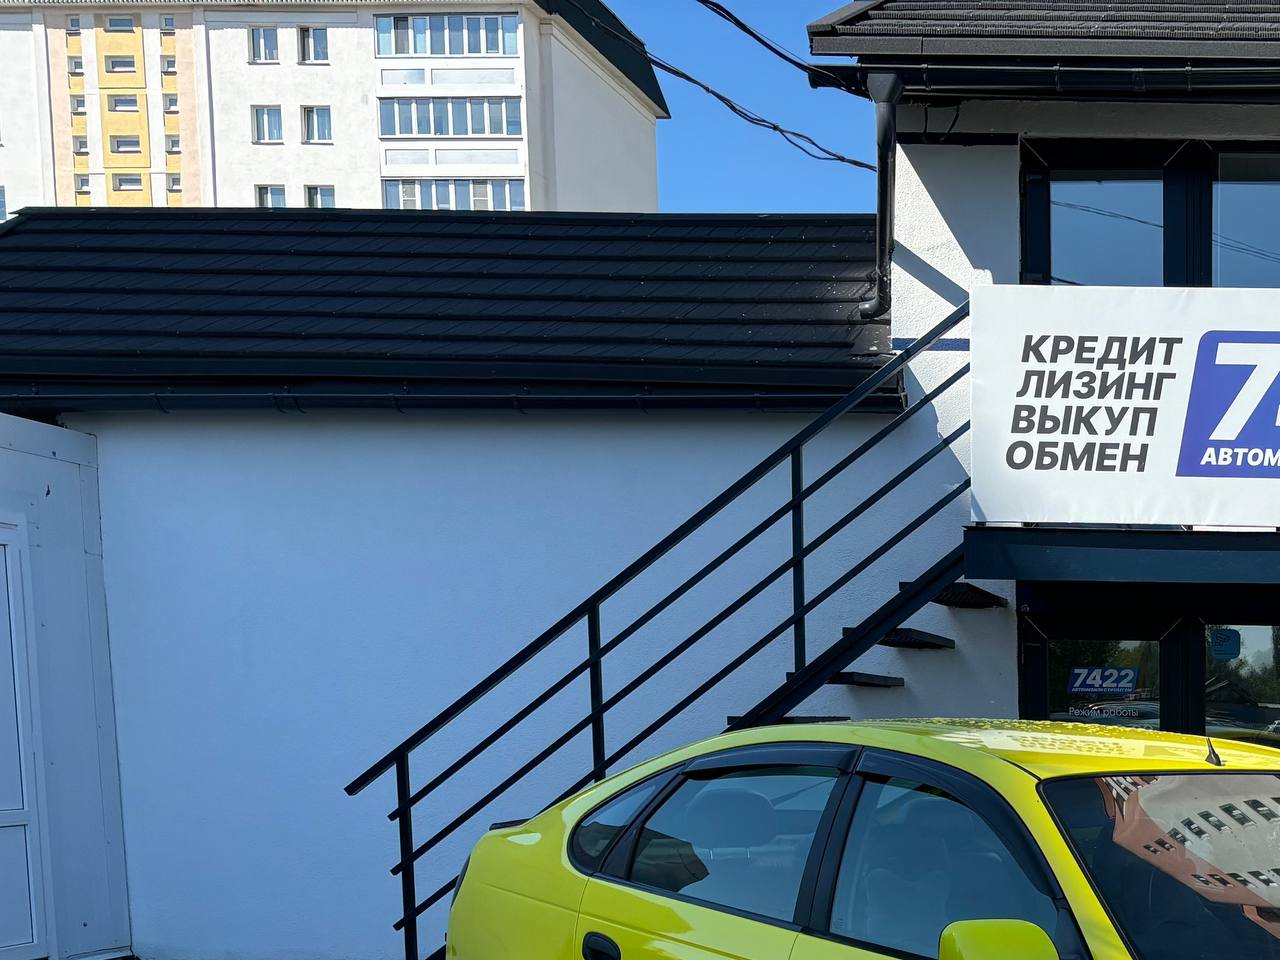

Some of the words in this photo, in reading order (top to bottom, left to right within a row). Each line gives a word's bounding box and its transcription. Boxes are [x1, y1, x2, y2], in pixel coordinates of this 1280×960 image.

[1021, 335, 1183, 370] КРЕДИТ
[1016, 370, 1176, 400] ЛИЗИНГ
[1011, 405, 1158, 436] ВЫКУП
[1006, 440, 1149, 472] ОБМЕН
[1073, 668, 1135, 688] 7422
[1068, 706, 1100, 716] Режим
[1102, 707, 1139, 718] работы
